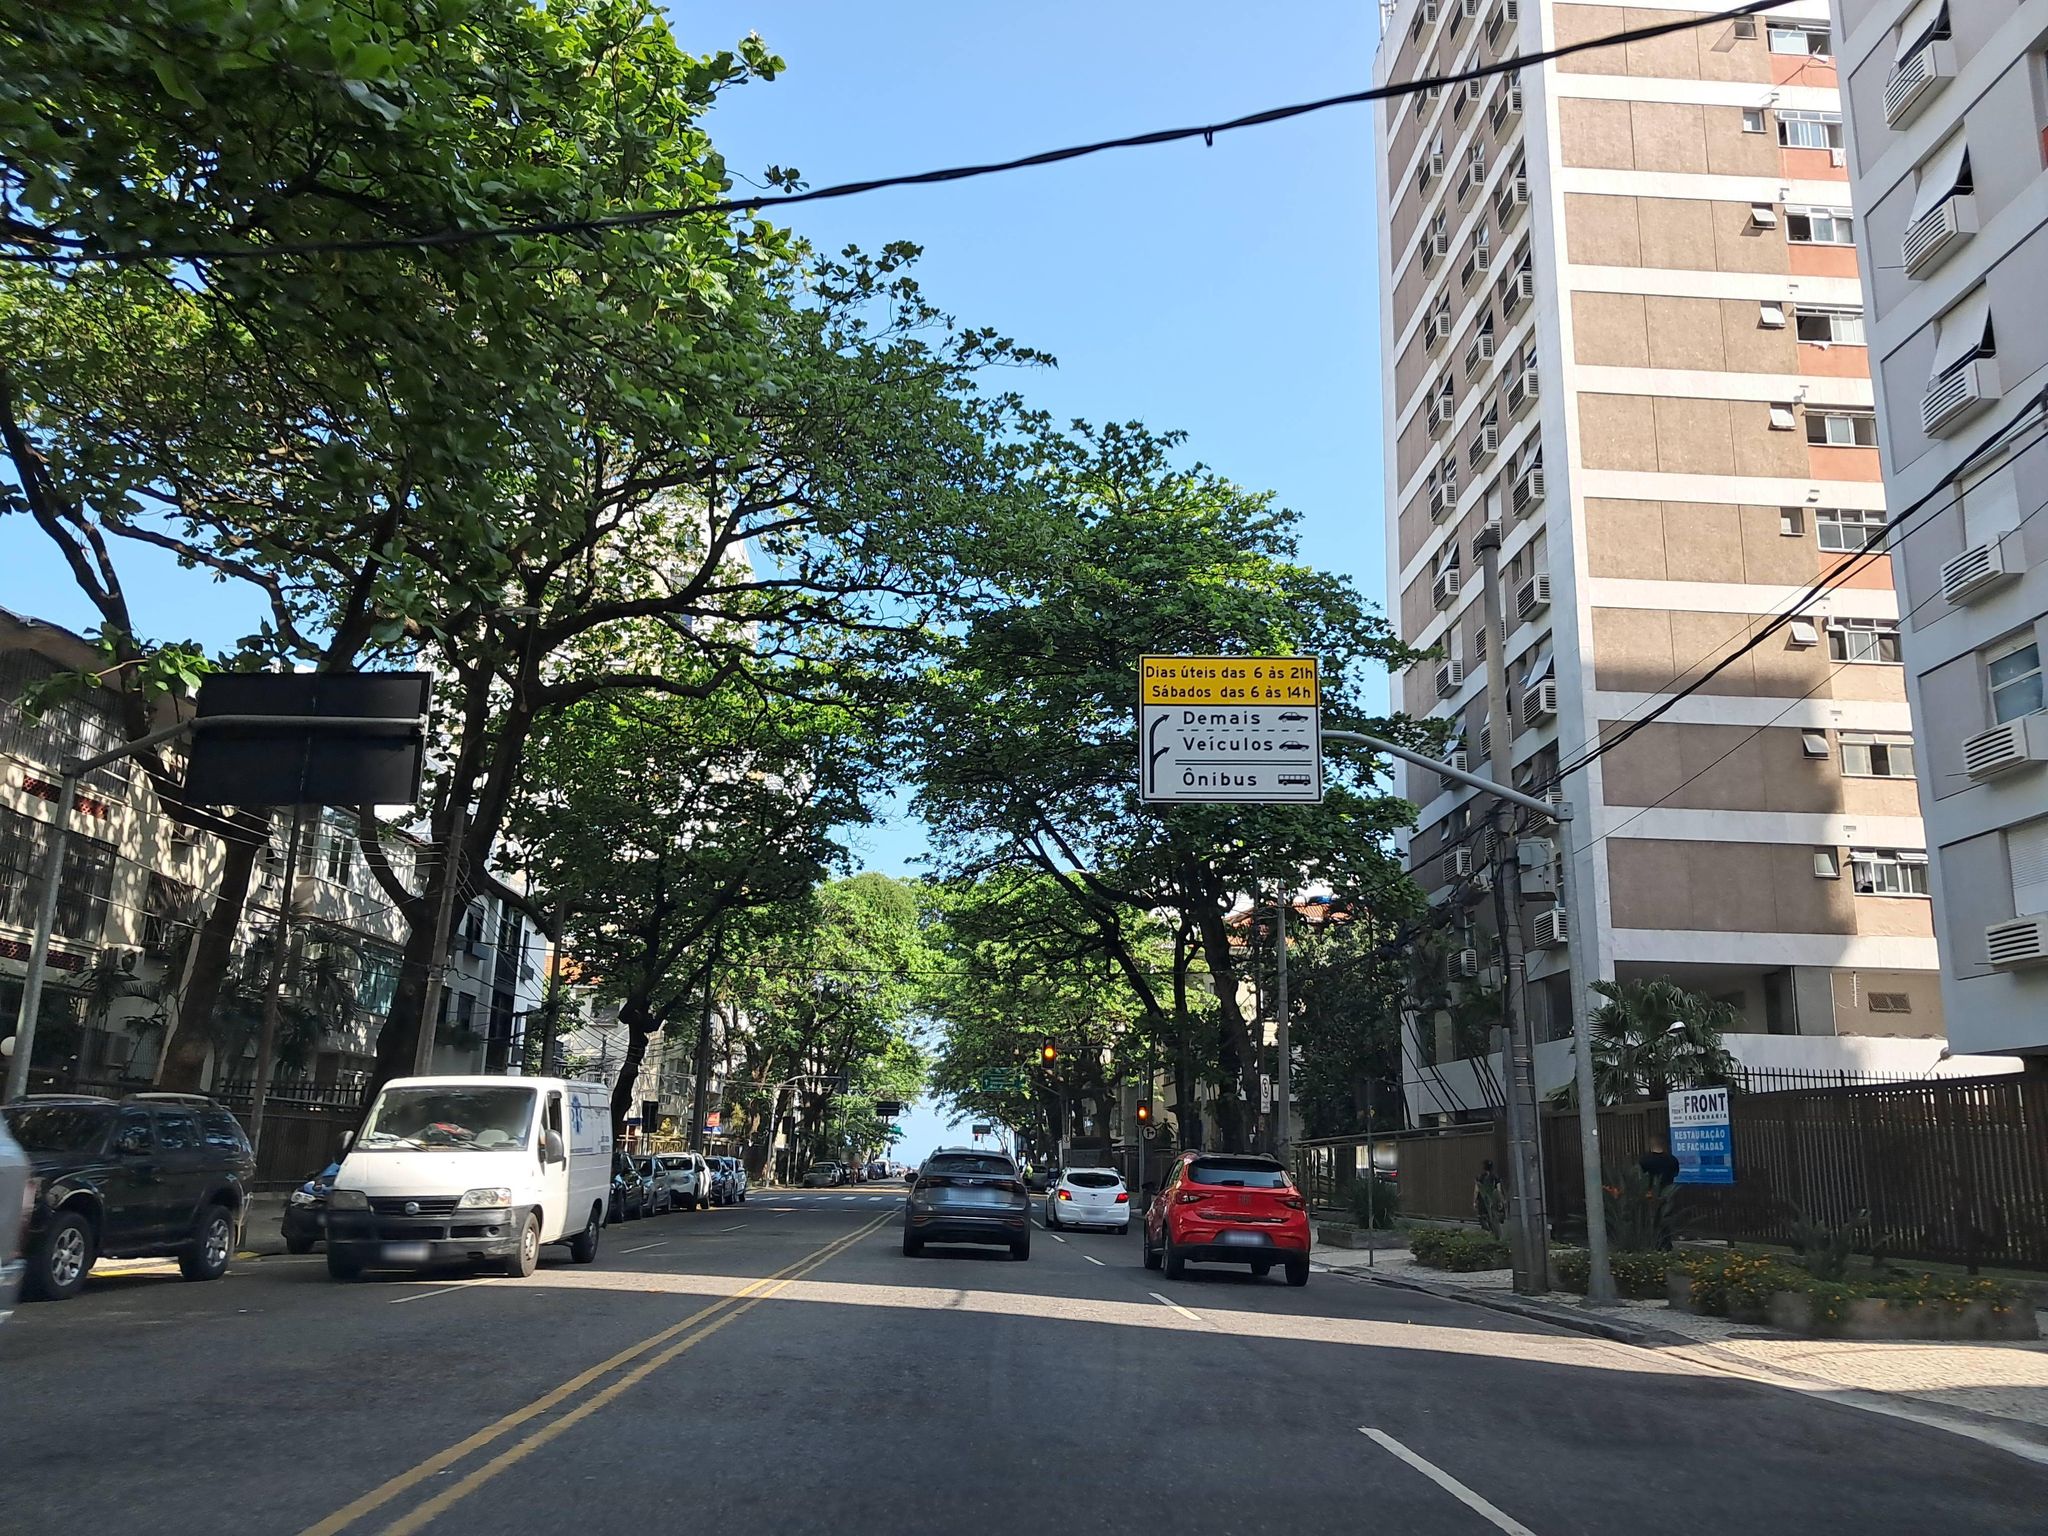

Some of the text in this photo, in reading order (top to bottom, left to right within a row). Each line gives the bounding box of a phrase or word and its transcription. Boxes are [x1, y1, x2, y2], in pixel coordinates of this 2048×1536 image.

[1146, 666, 1313, 679] Dias úteis das 6 às 21h
[1152, 685, 1310, 698] Sábados das 6 às 14h
[1184, 711, 1260, 725] Demais
[1183, 736, 1273, 751] Veículos
[1183, 768, 1257, 786] Ônibus
[1684, 1093, 1725, 1113] FRONT
[1674, 1128, 1725, 1140] RESTAURAÇÃO
[1677, 1141, 1724, 1151] DE FACHADAS
